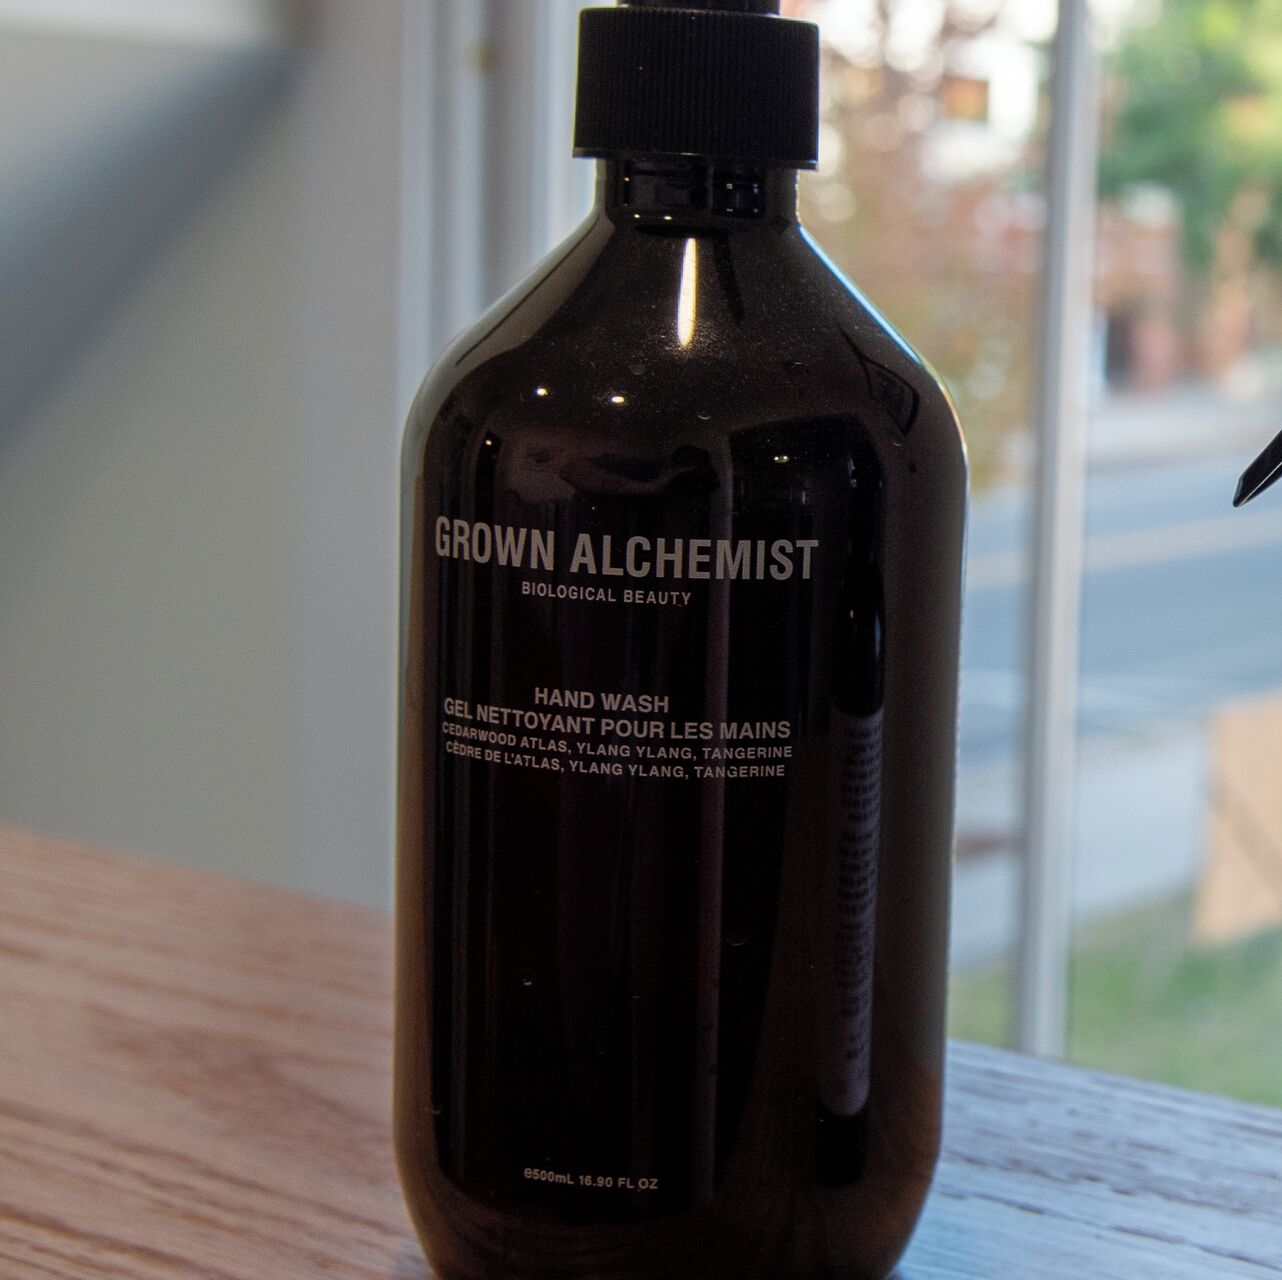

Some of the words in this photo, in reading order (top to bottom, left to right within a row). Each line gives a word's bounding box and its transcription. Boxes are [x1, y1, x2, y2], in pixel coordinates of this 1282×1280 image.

[435, 516, 555, 571] GROWN
[569, 534, 820, 581] ALCHEMIST
[521, 581, 617, 602] BIOLOGICAL
[623, 589, 692, 605] BEAUTY
[534, 687, 595, 709] HAND
[601, 693, 669, 713] WASH
[444, 697, 473, 719] GEL
[476, 704, 596, 735] NETTOYANT
[601, 718, 664, 738] POUR
[670, 722, 713, 740] LES
[720, 721, 791, 739] MAINS
[442, 721, 517, 746] CEDARWOOD
[520, 736, 572, 755] ATLAS,
[577, 742, 631, 758] YLANG
[636, 746, 697, 761] YLANG,
[702, 746, 793, 760] TANGERINE
[484, 749, 502, 763] DE
[504, 752, 565, 773] L'ATLAS,
[569, 760, 623, 776] YLANG
[628, 764, 689, 779] YLANG,
[694, 765, 785, 778] TANGERINE
[579, 1175, 613, 1188] 16.90
[618, 1177, 635, 1189] FL
[638, 1178, 659, 1189] OZ
